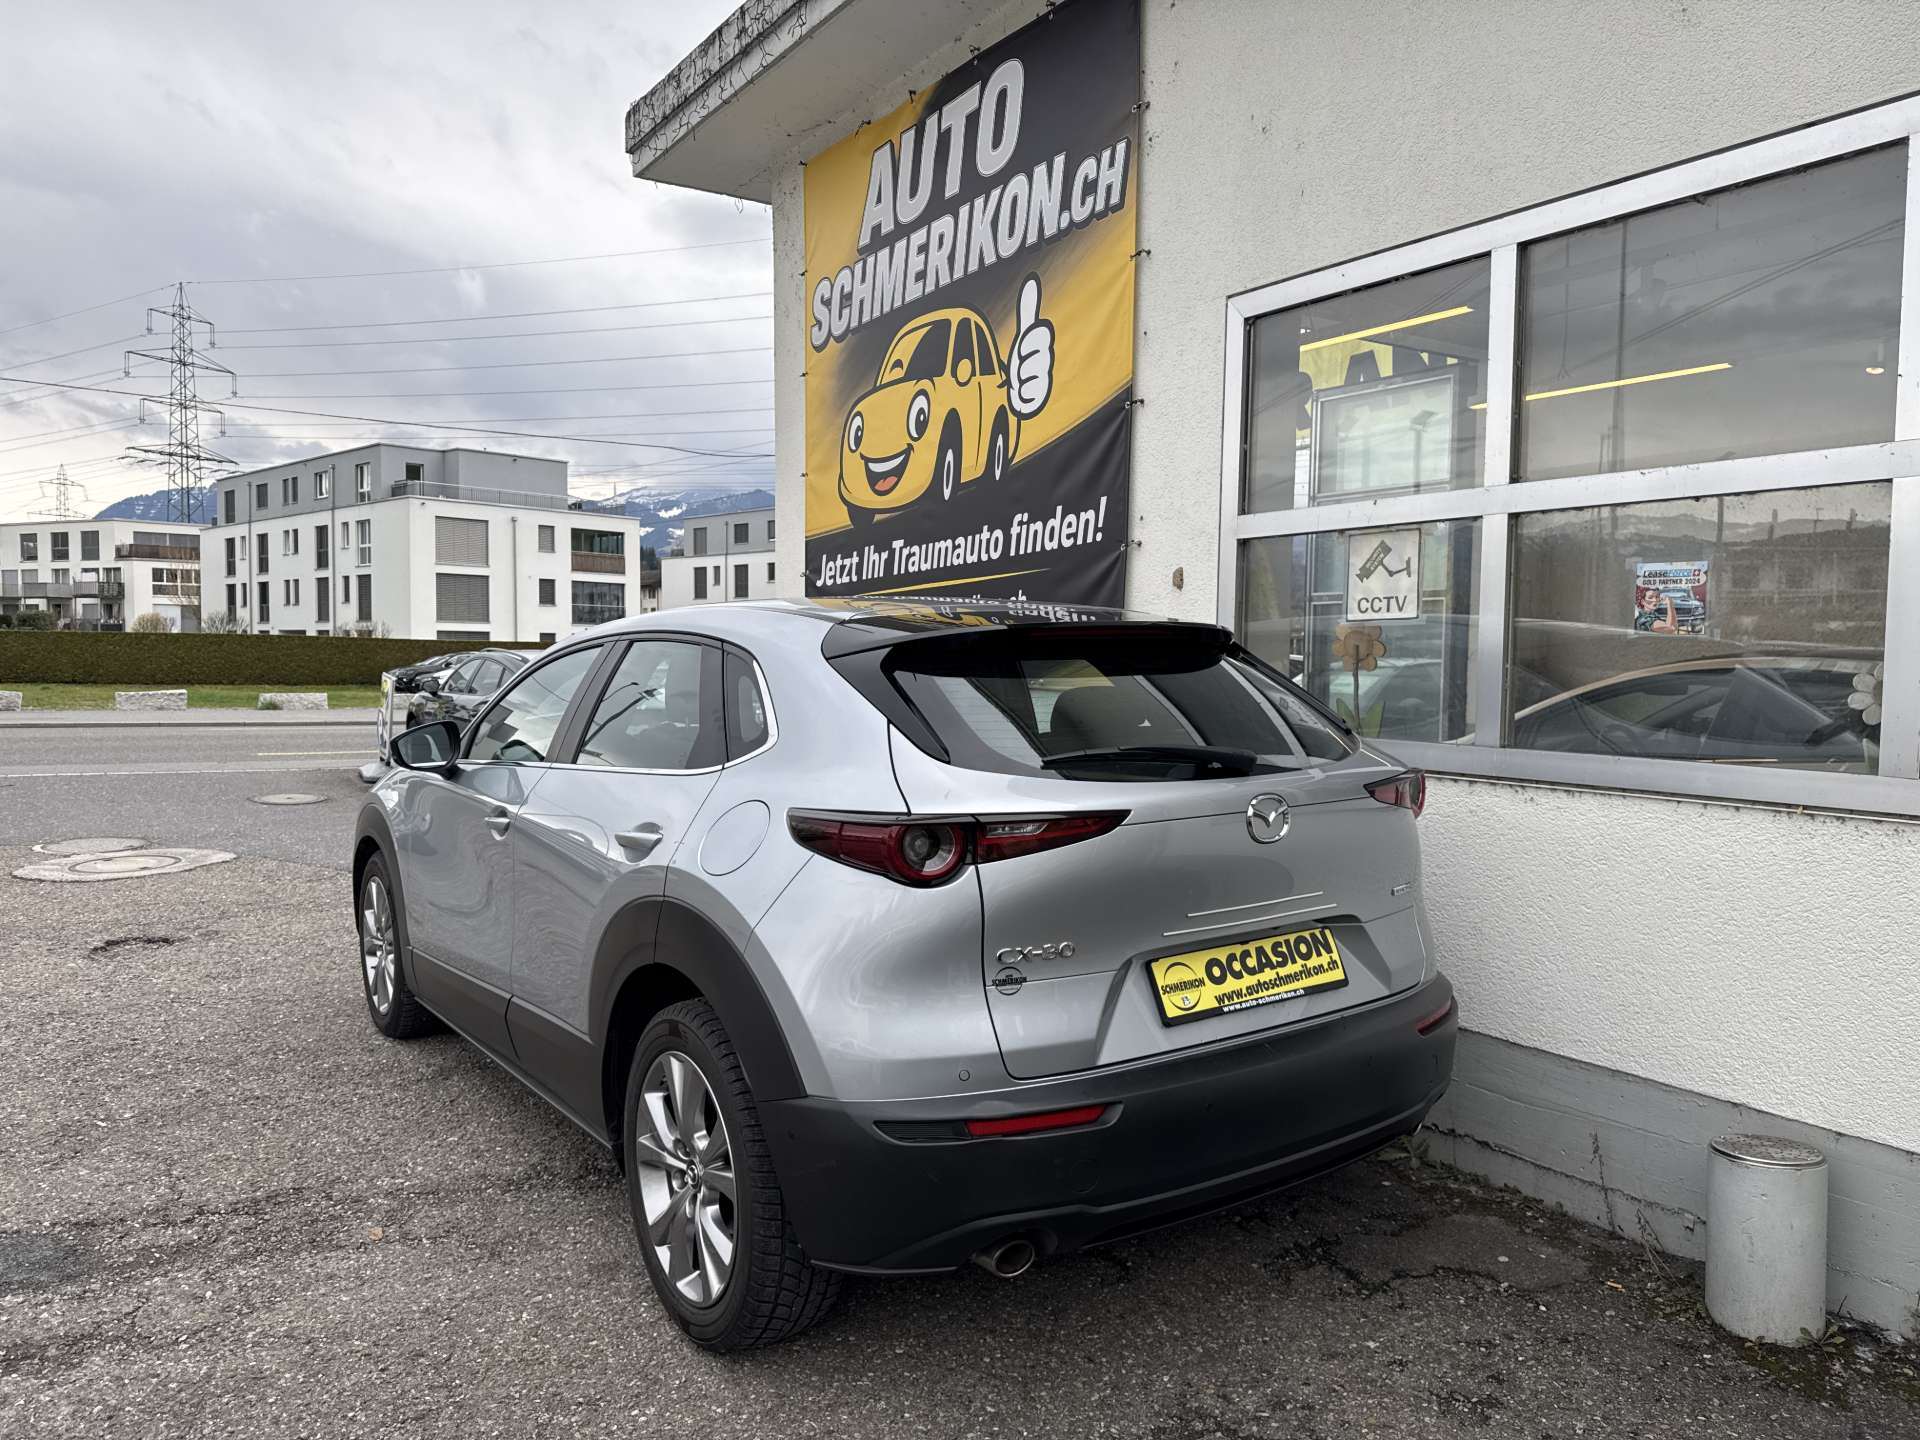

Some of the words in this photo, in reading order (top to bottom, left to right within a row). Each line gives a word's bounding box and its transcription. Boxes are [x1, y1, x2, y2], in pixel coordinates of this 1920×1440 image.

[857, 58, 1025, 250] AUTO
[811, 138, 1128, 349] SCHMERIKON.CH
[815, 550, 859, 587] Jetzt
[862, 545, 888, 580] Ihr
[892, 524, 1004, 574] Traumauto
[1010, 496, 1108, 556] finden!
[1357, 595, 1408, 614] CCTV
[996, 941, 1075, 965] CX-30
[1204, 928, 1334, 986] OCCASION
[1161, 977, 1206, 995] SCHMERIKON
[1214, 956, 1340, 1006] www.autoschmerikon.ch
[1222, 988, 1306, 1013] www.auto-schmerikon.ch
